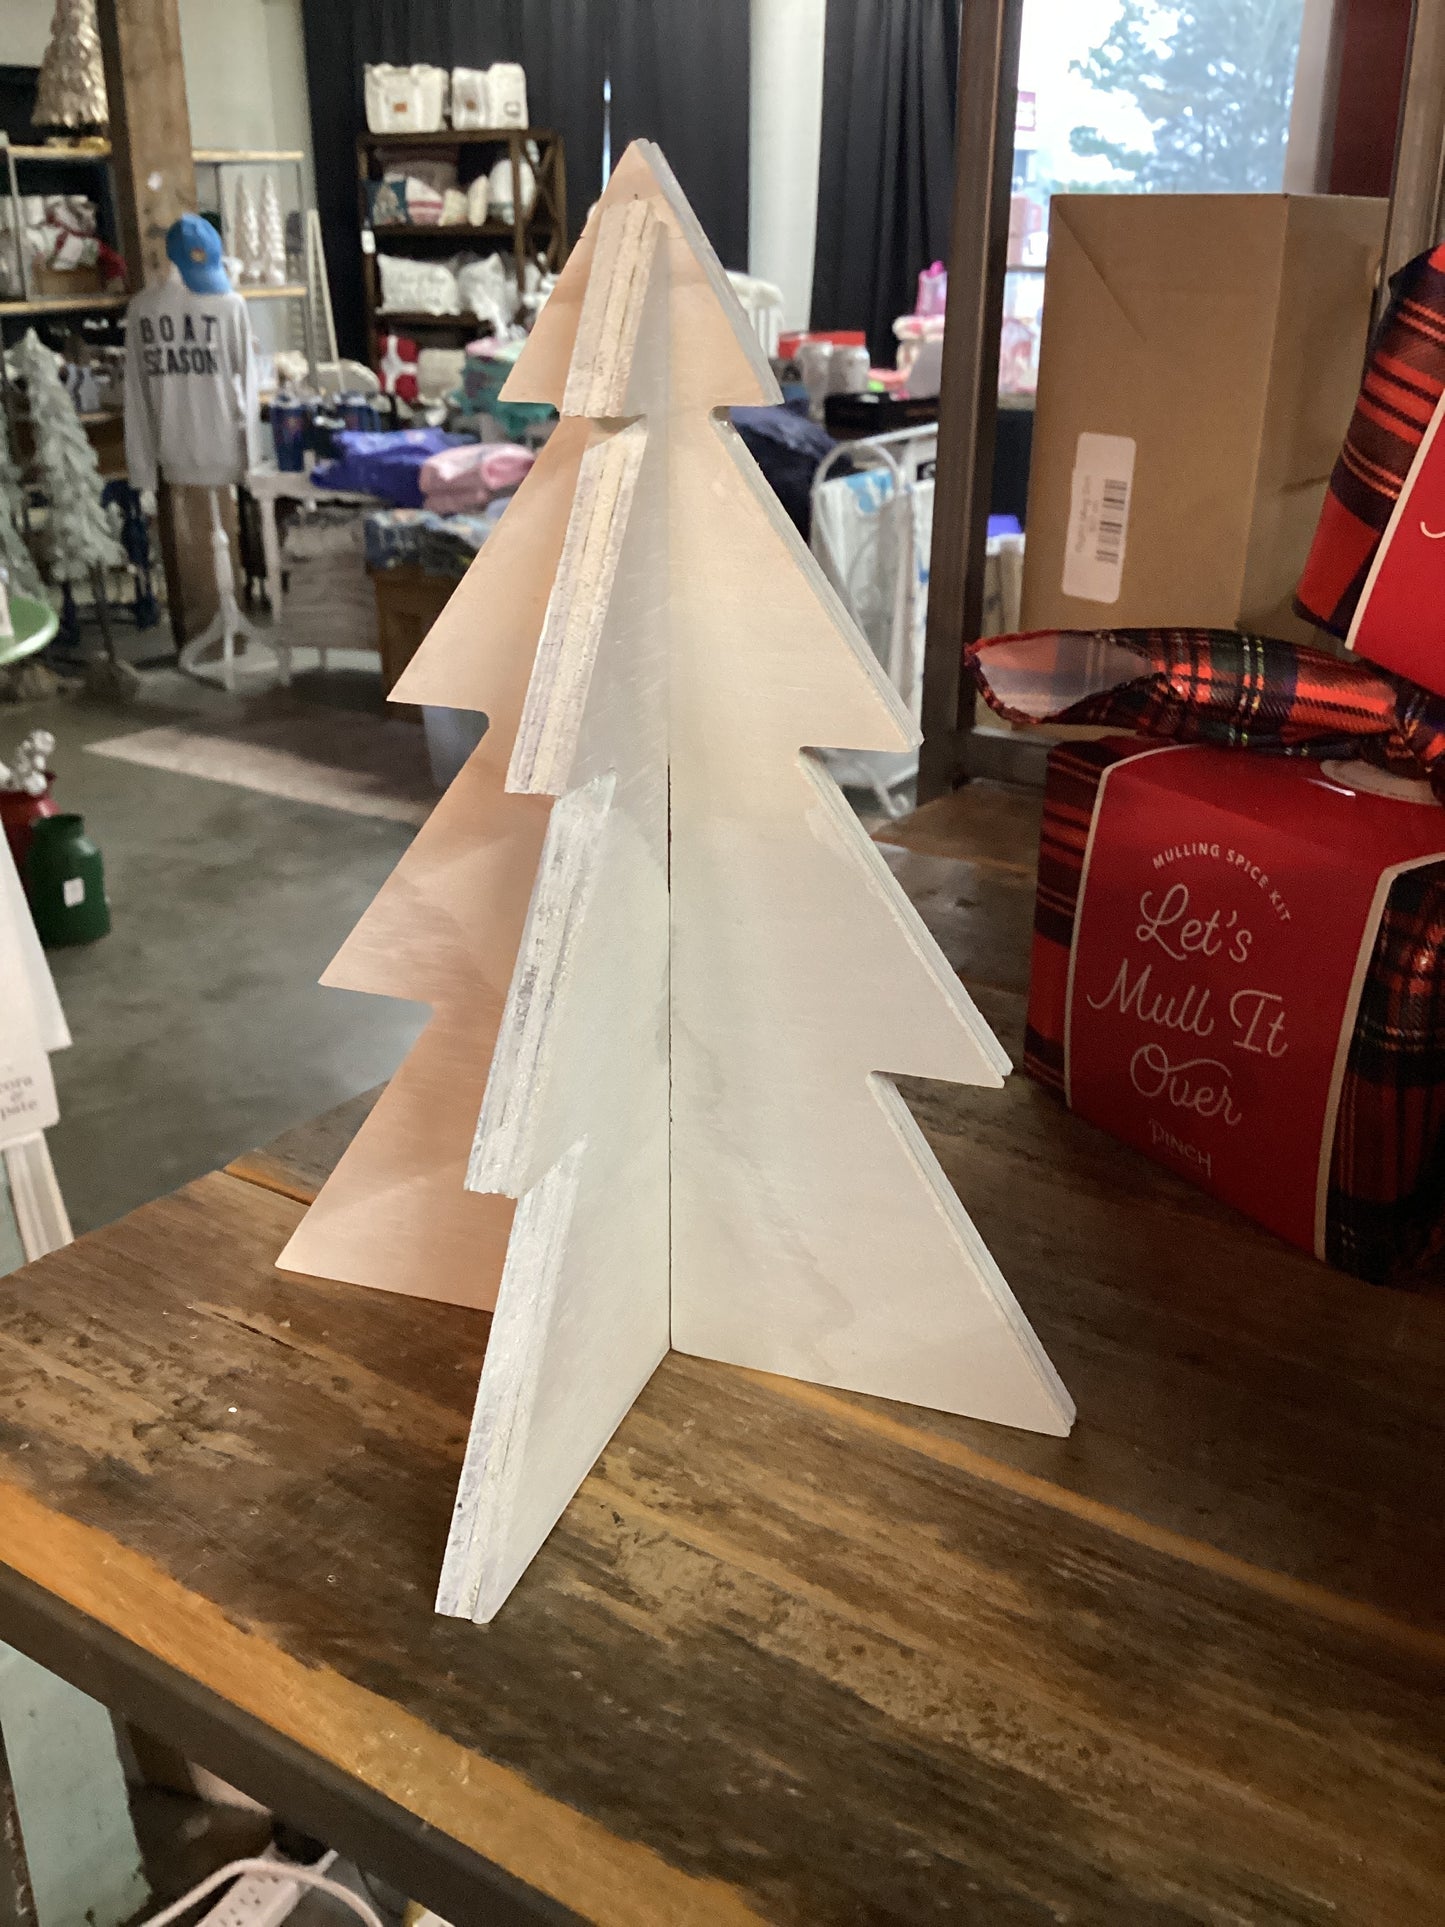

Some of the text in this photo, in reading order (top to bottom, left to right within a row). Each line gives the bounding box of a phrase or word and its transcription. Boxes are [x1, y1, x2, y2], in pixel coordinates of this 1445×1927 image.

[139, 313, 218, 343] BOAT
[1152, 842, 1293, 923] MULLING SPICE KIT
[1135, 883, 1253, 963] Let's
[1086, 958, 1289, 1058] Mull It
[1129, 1043, 1243, 1126] Over
[1149, 1119, 1212, 1179] PINCH
